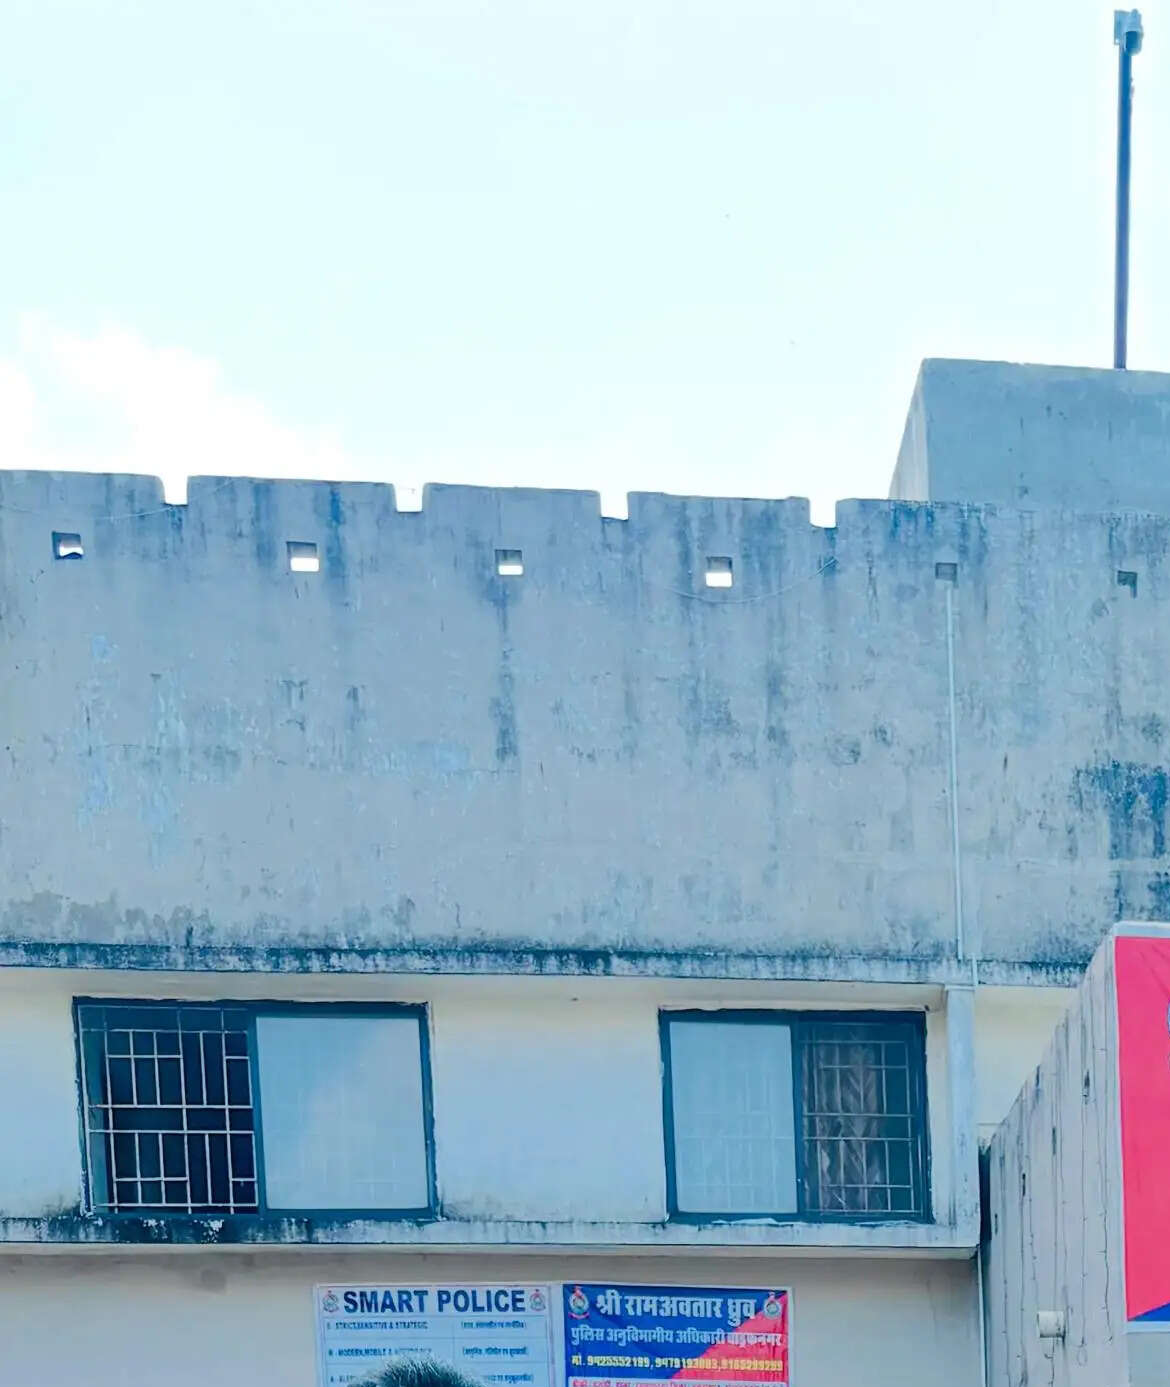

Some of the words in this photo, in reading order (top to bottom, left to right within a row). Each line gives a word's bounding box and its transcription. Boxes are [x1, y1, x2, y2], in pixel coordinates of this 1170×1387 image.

[343, 1289, 429, 1313] SMART
[437, 1289, 526, 1313] POLICE
[596, 1290, 621, 1316] श्री
[571, 1325, 604, 1346] पुलिस
